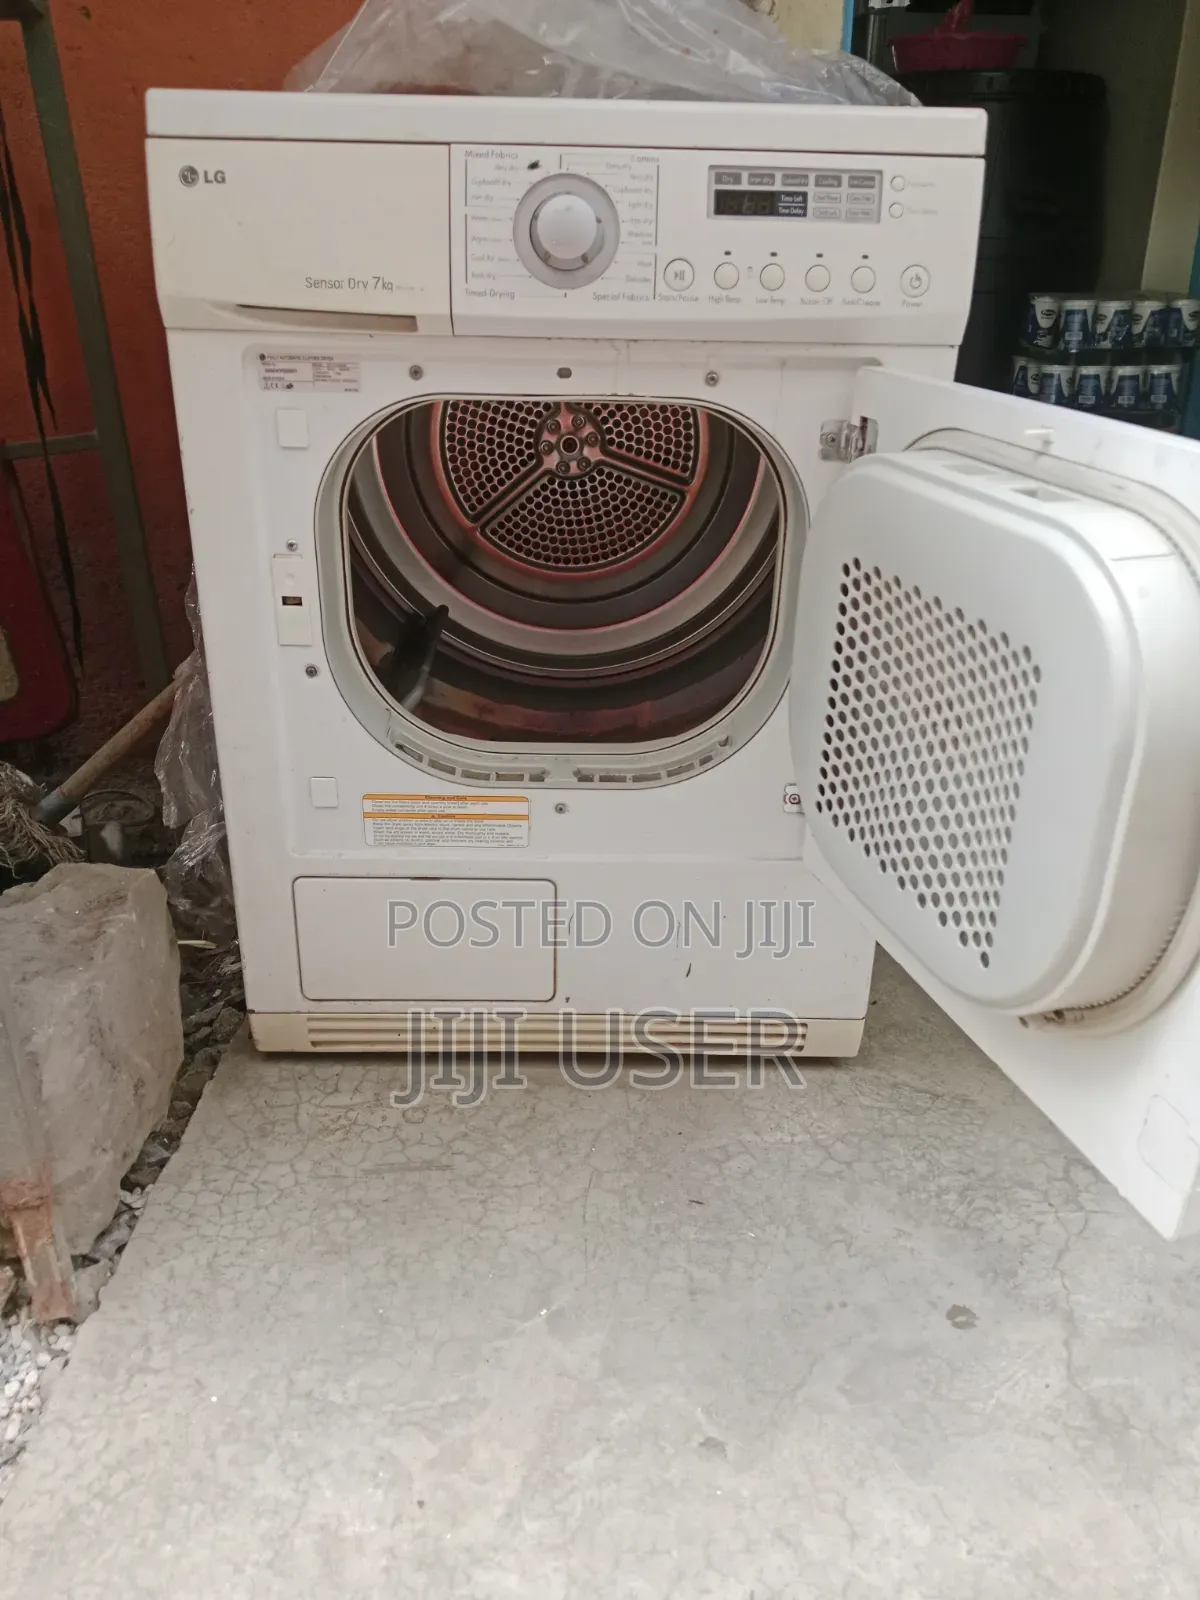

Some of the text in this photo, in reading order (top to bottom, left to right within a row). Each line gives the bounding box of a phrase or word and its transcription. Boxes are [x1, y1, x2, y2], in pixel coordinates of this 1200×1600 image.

[465, 150, 519, 159] Mixed Fabrics
[203, 170, 226, 184] LG
[305, 277, 344, 289] Sensor
[372, 276, 394, 291] 7kg
